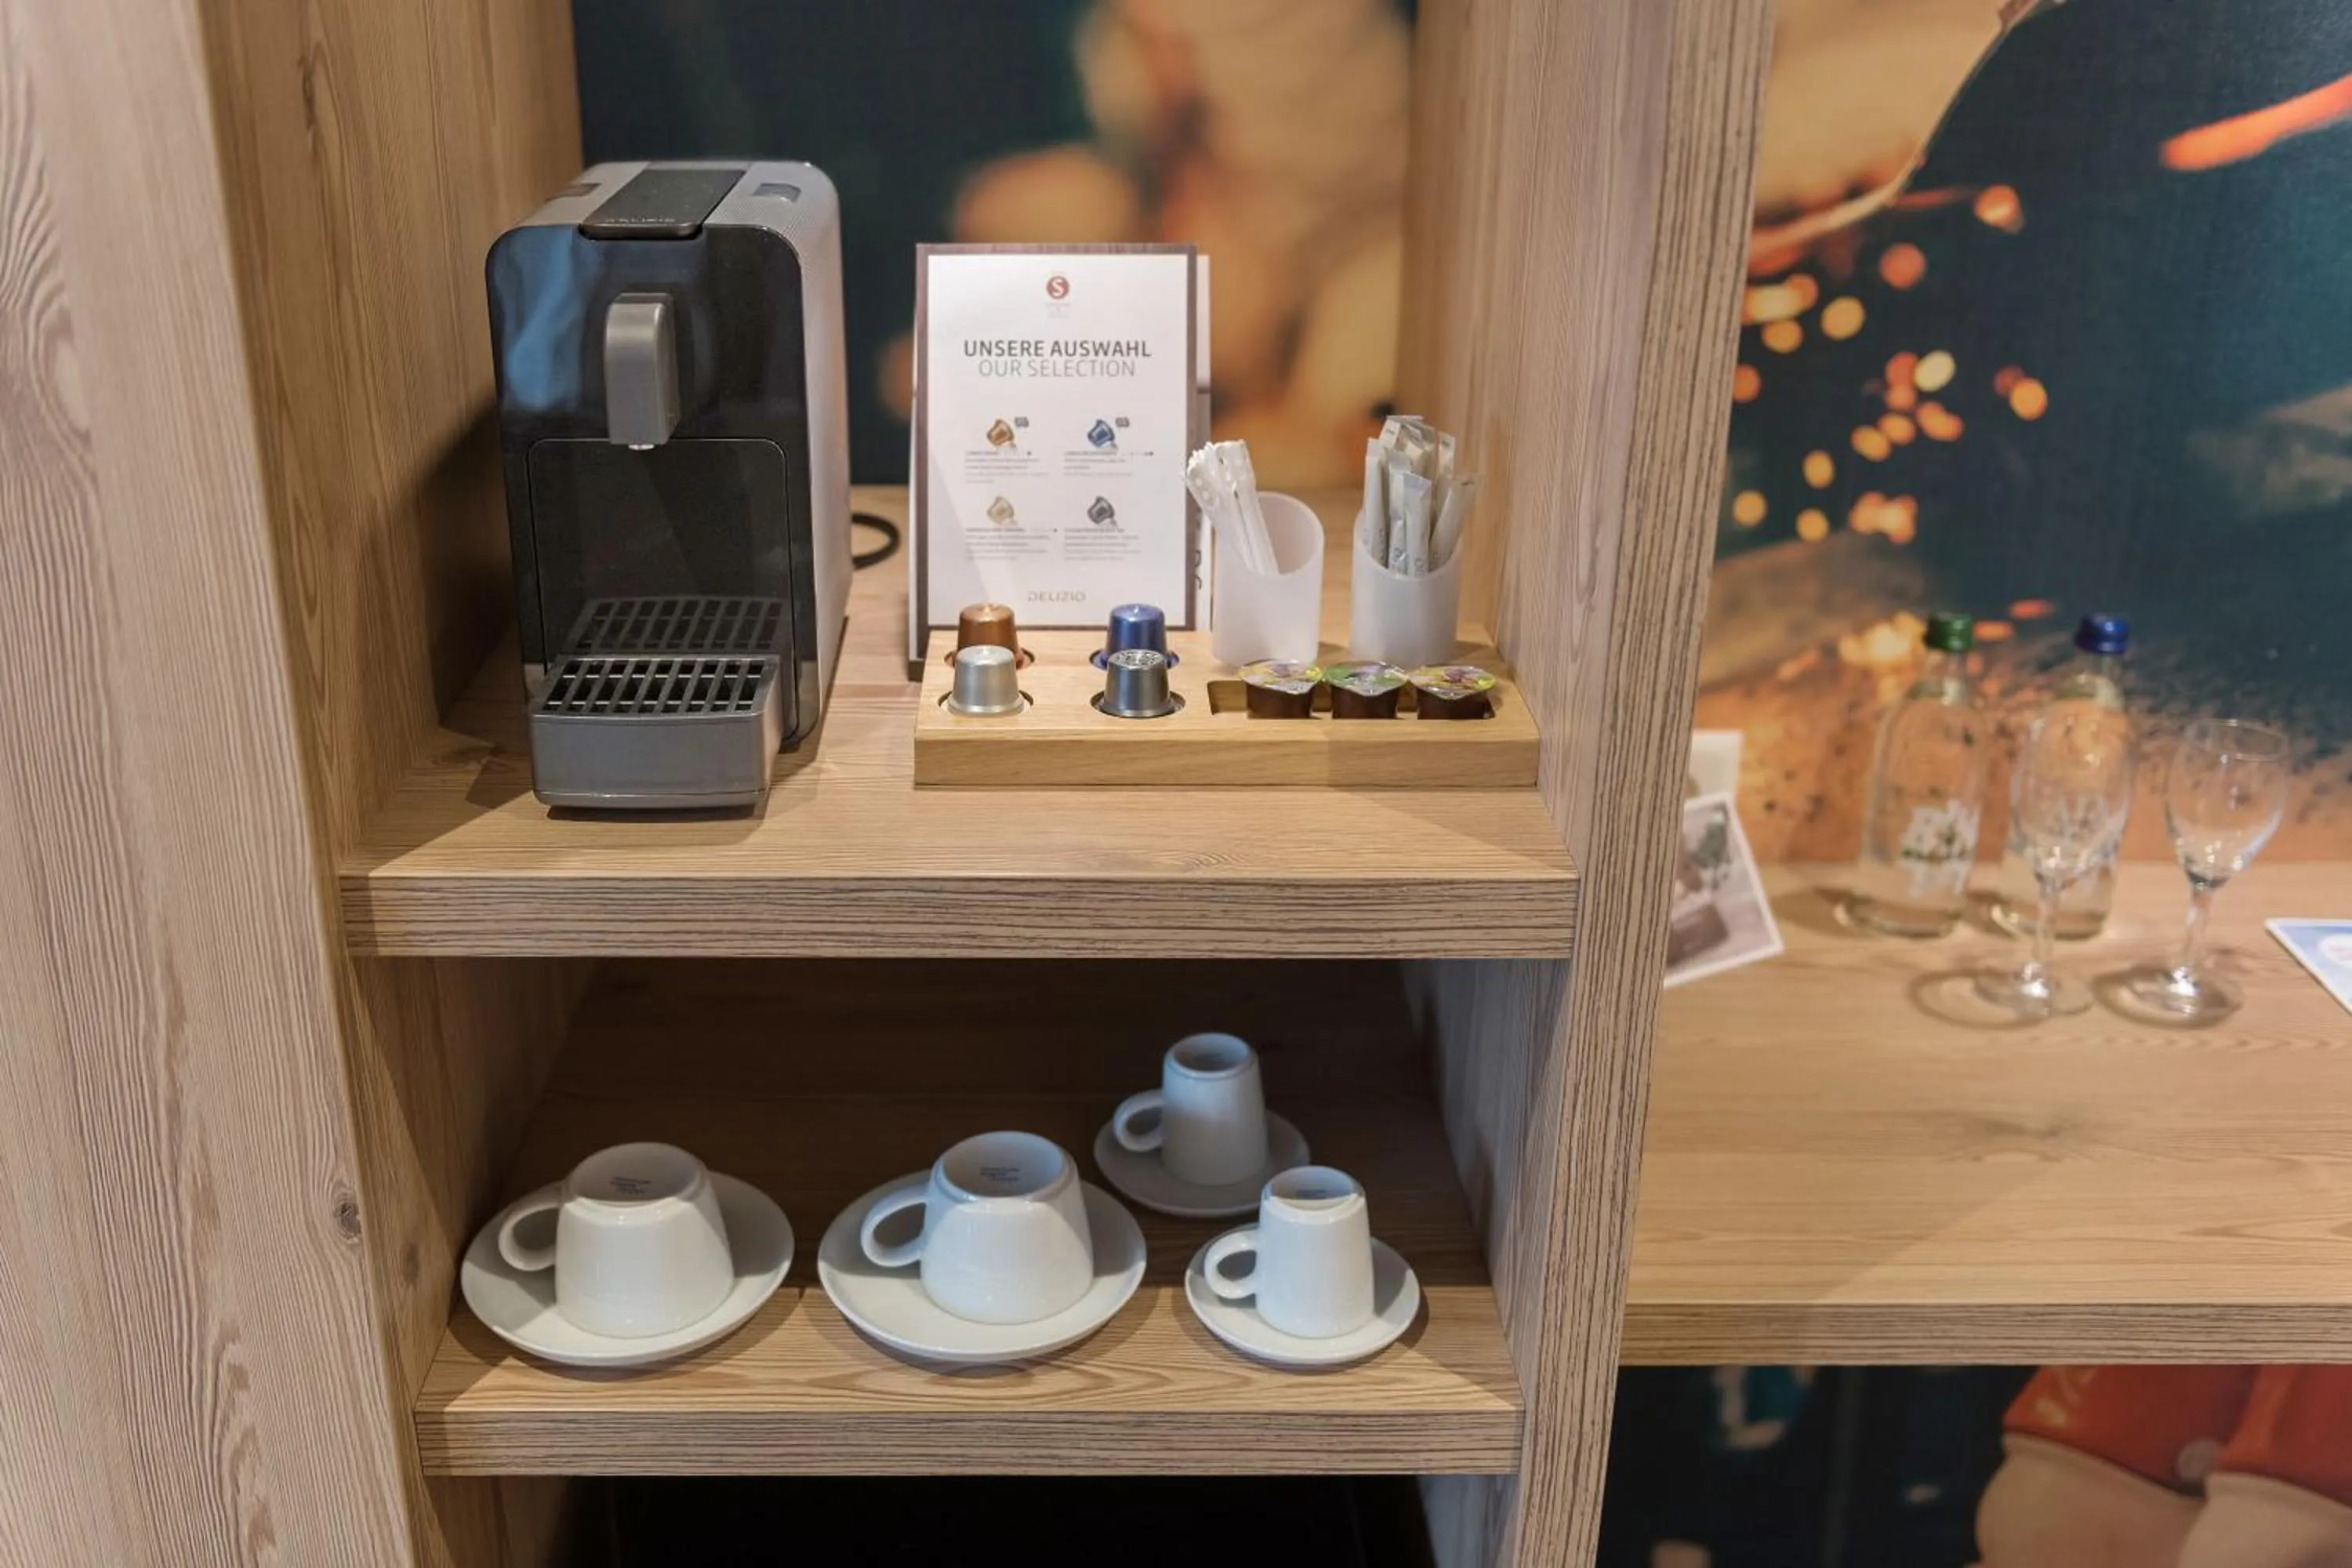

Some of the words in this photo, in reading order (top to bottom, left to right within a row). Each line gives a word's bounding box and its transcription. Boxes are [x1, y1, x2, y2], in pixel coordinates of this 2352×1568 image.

[1051, 278, 1065, 298] S
[964, 339, 1044, 358] UNSERE
[1050, 339, 1152, 358] AUSWAHL
[978, 358, 1022, 377] OUR
[1028, 358, 1135, 377] SELECTION
